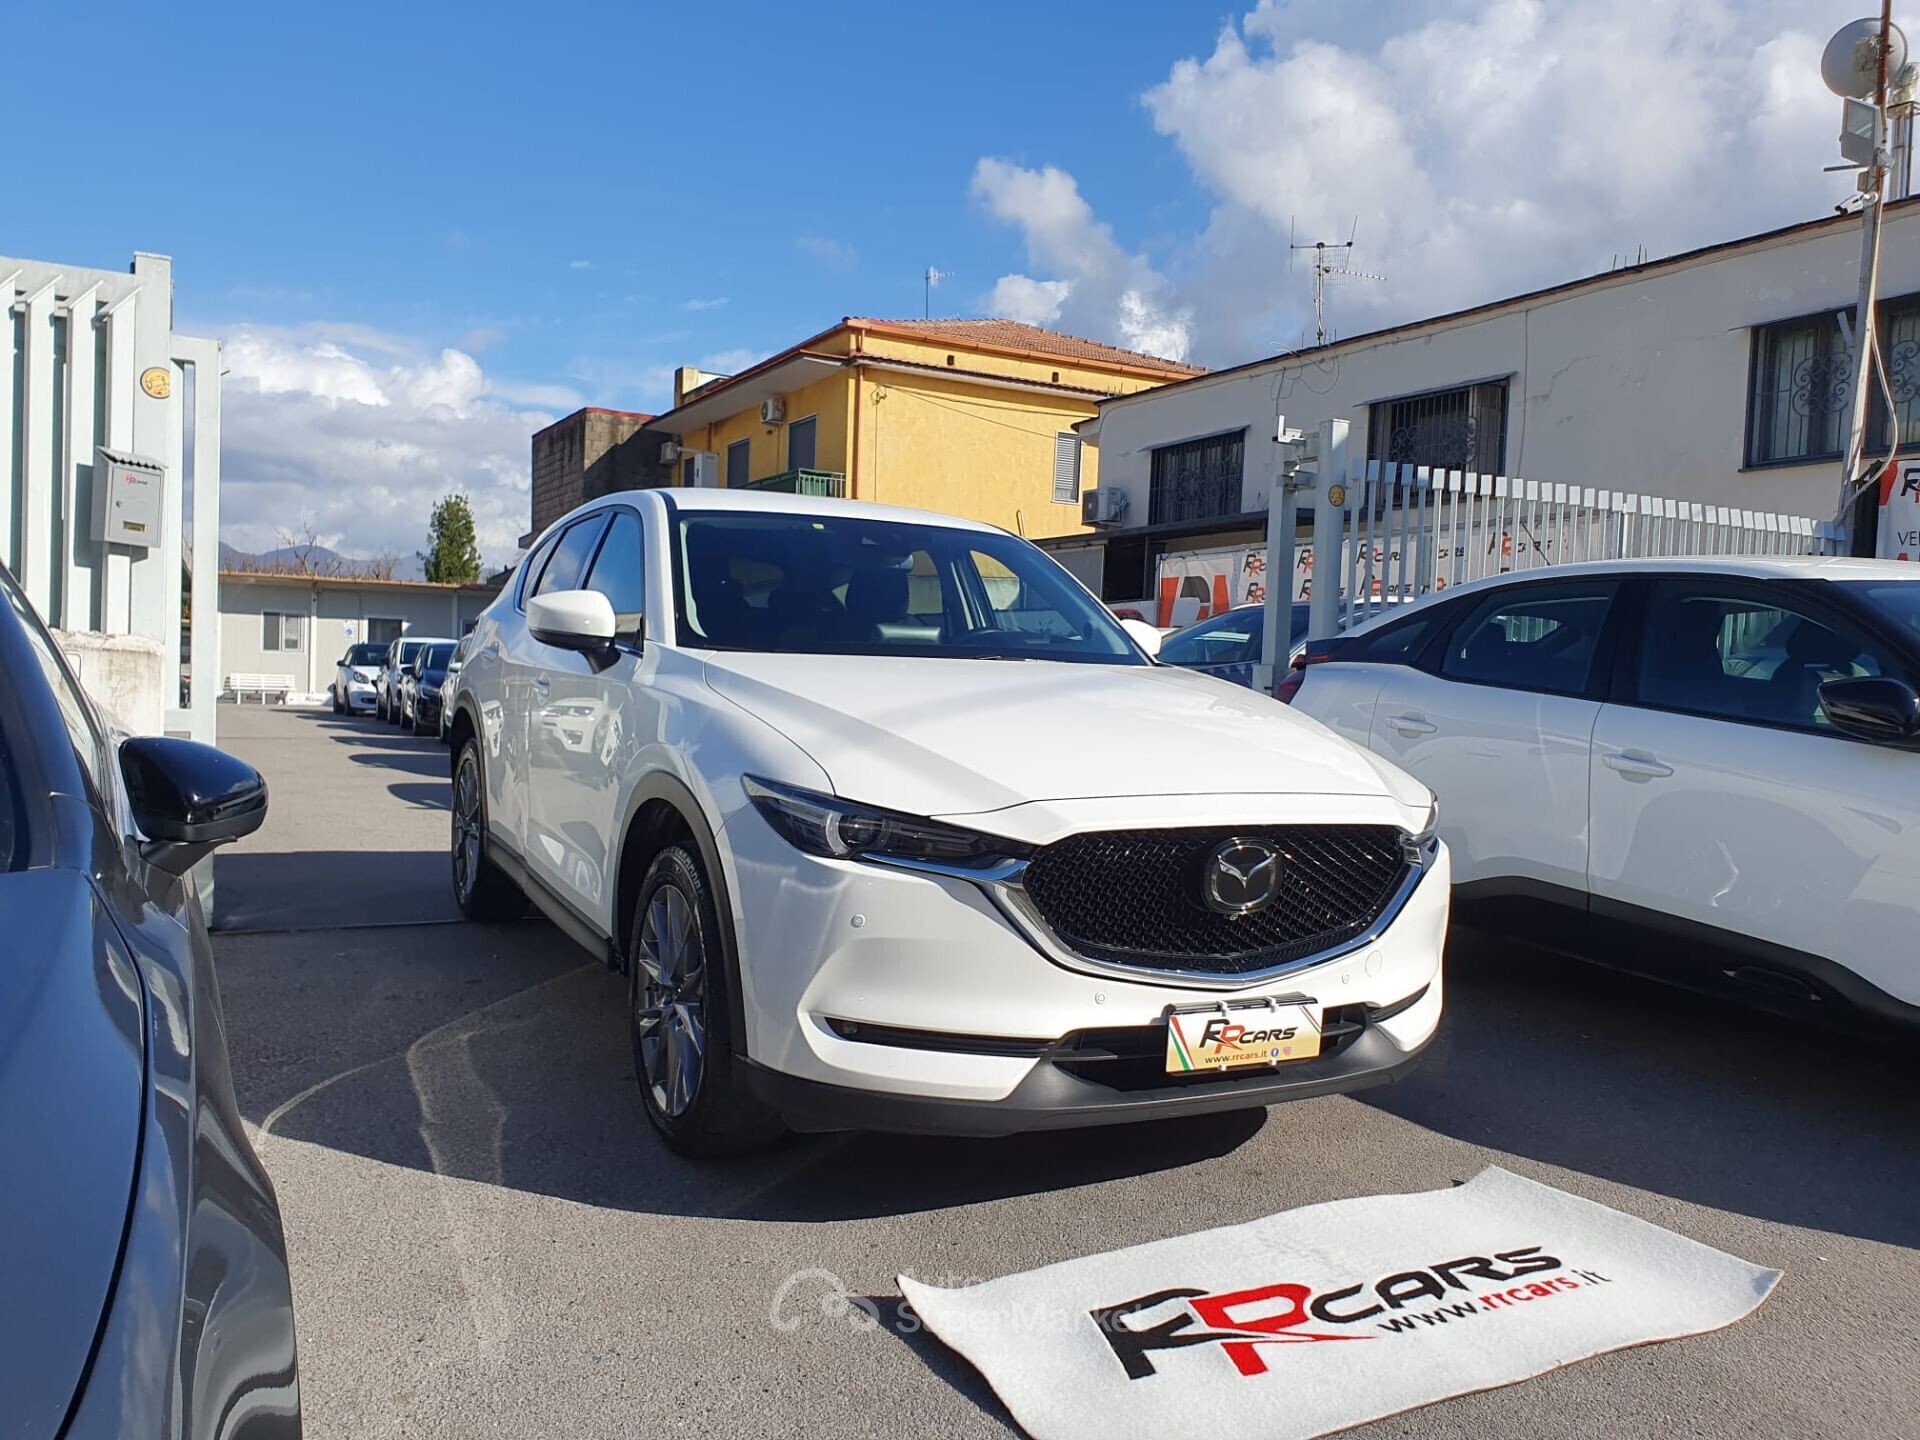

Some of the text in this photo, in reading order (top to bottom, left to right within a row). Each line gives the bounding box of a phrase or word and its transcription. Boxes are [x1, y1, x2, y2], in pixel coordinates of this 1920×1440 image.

[1897, 531, 1920, 547] VE
[1205, 1049, 1267, 1064] www.rrcars.it
[1378, 1268, 1614, 1334] www.rrcars.it
